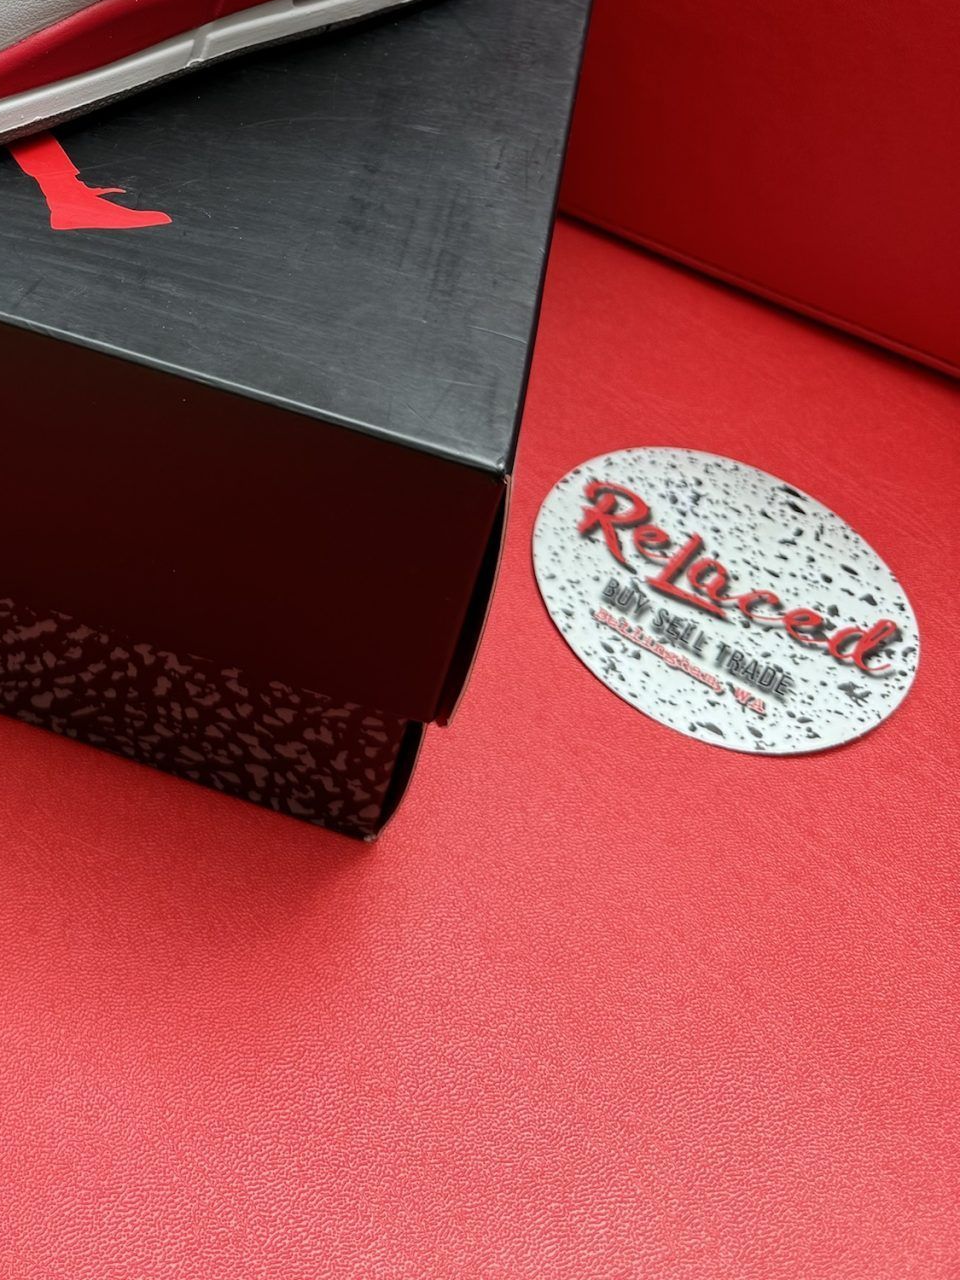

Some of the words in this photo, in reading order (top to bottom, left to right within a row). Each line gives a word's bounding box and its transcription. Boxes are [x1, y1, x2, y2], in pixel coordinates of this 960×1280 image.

[602, 577, 650, 615] BUY
[652, 608, 709, 652] SELL
[716, 641, 795, 696] TRADE
[733, 686, 767, 715] WA
